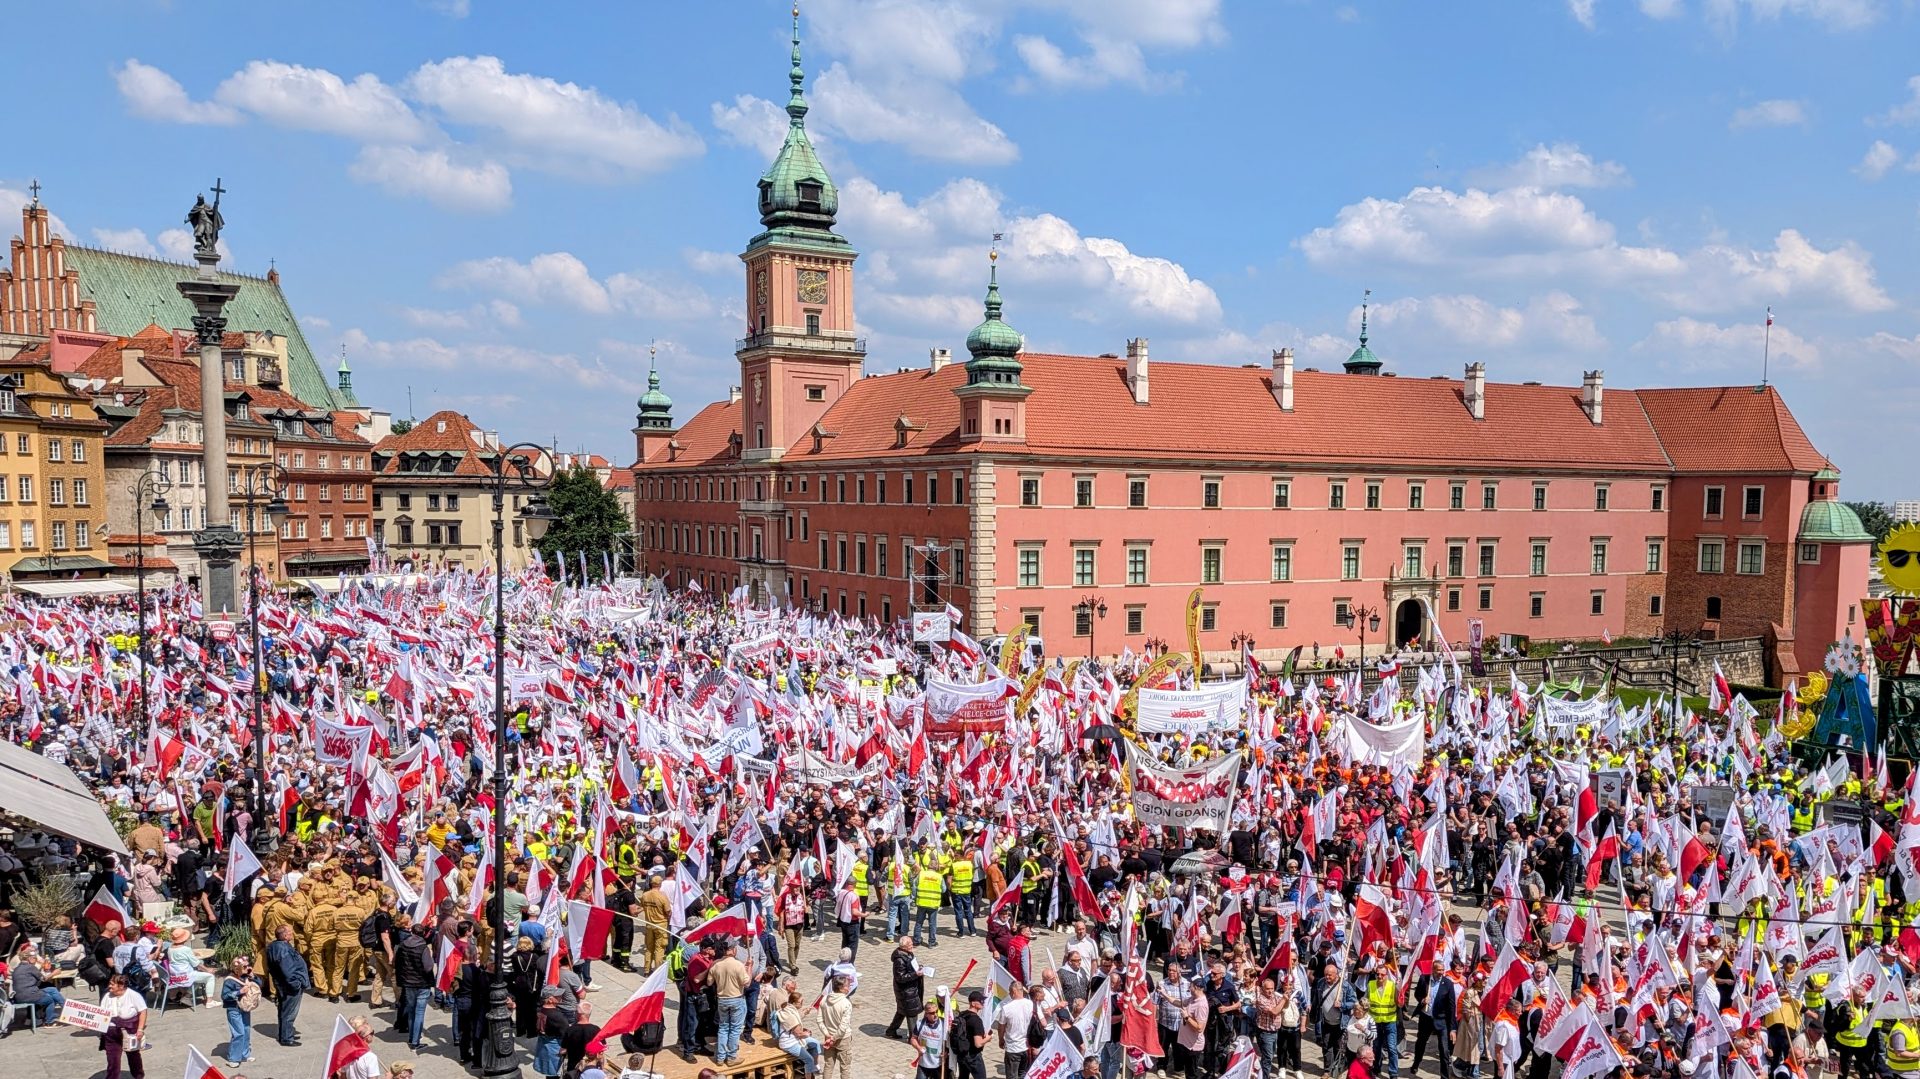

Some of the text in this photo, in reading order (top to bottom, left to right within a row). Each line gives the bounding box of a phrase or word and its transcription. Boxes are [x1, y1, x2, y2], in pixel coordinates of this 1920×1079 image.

[1135, 799, 1171, 817] EGION
[66, 1001, 111, 1016] DEMORALIZACJA
[86, 1012, 95, 1020] NIE
